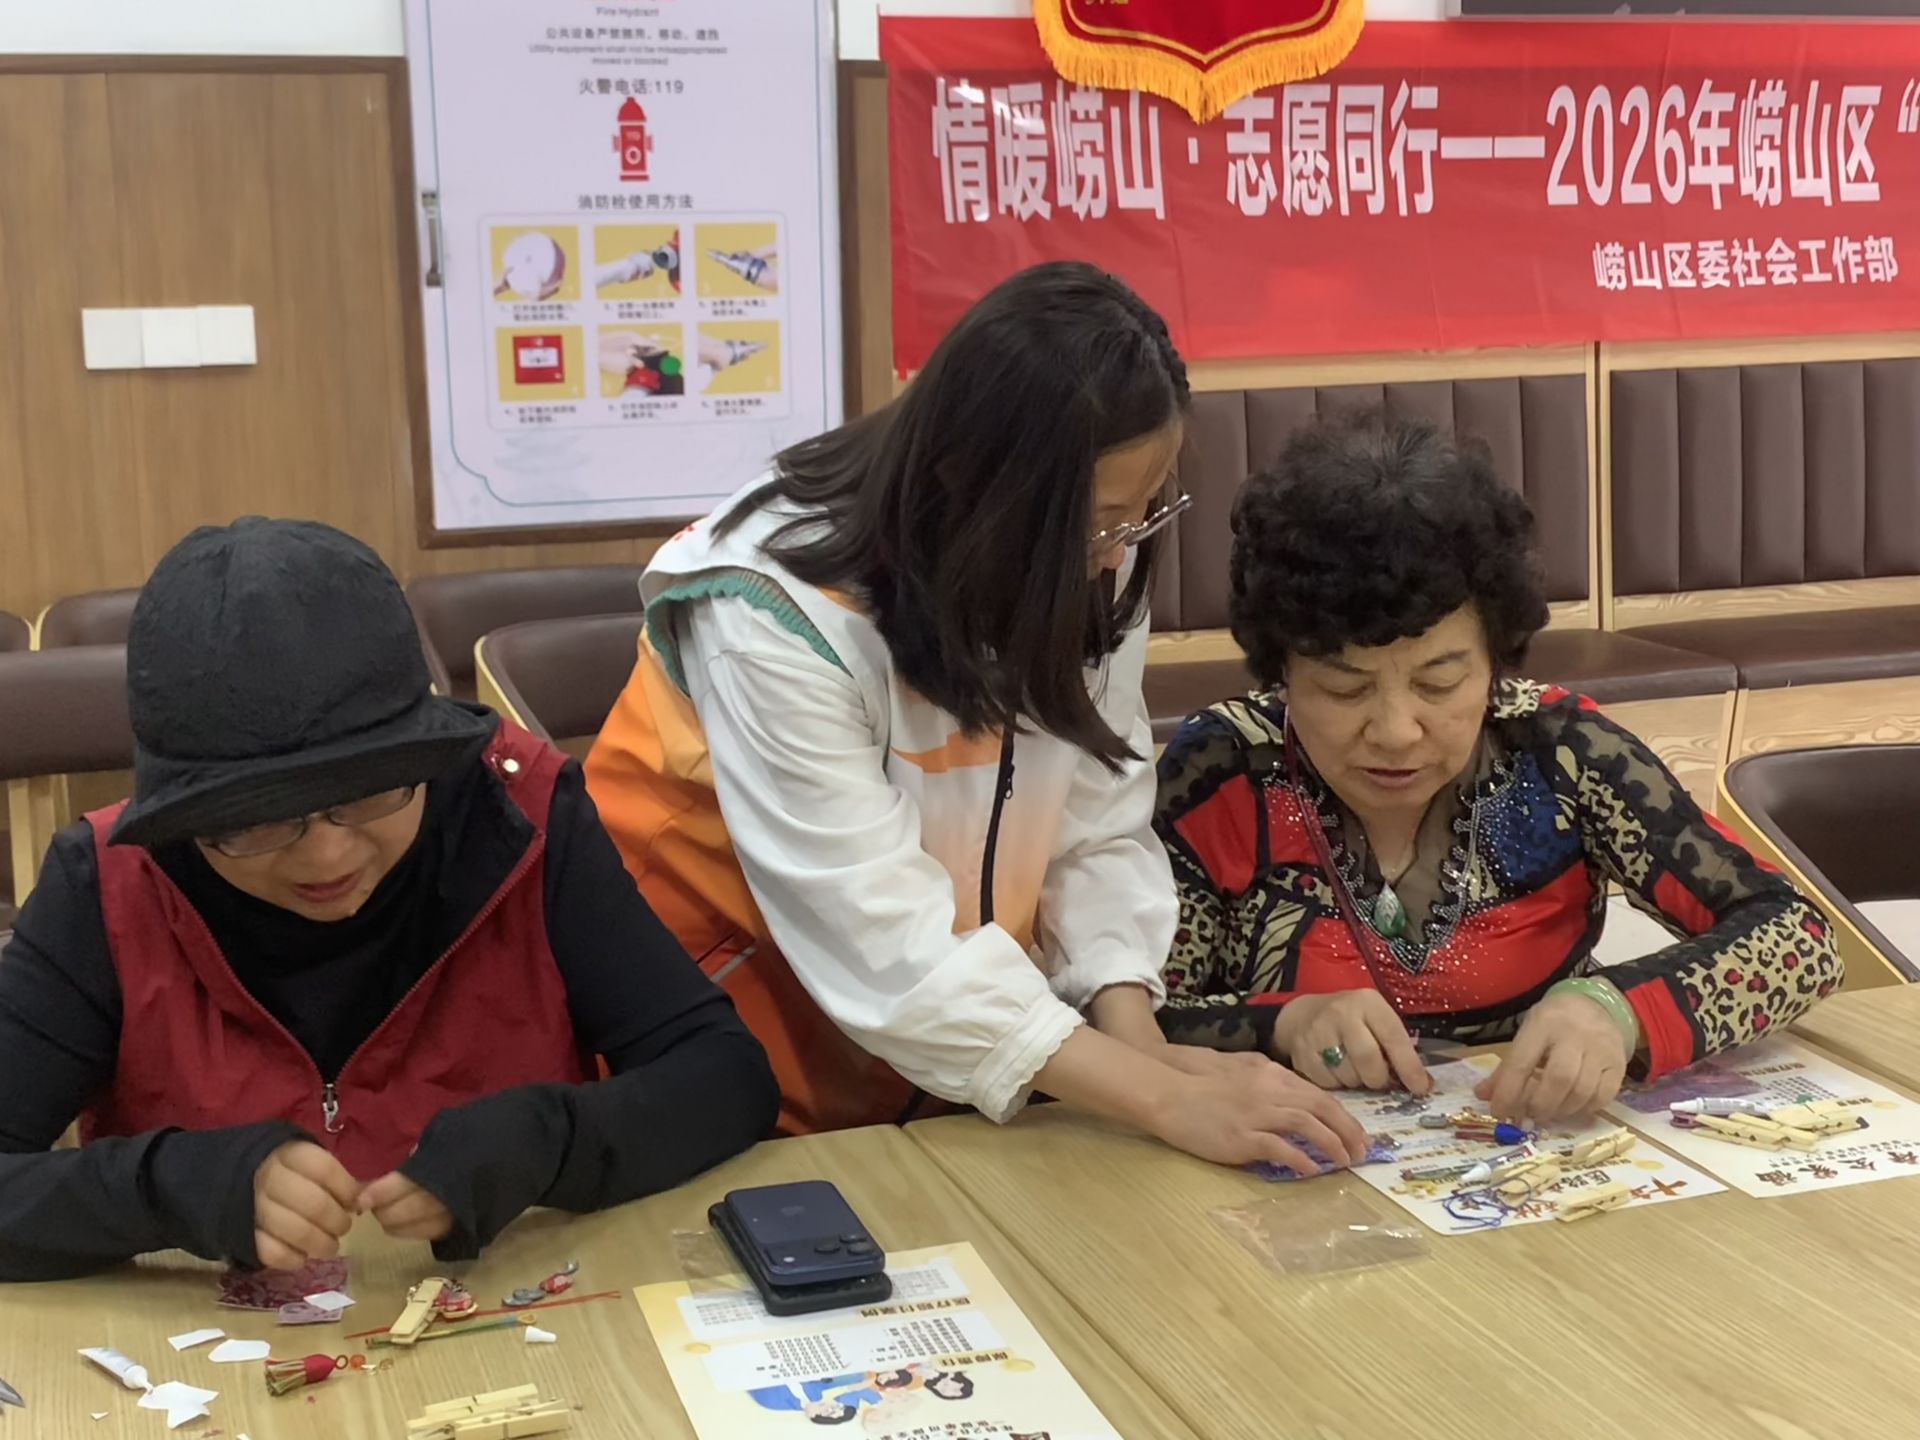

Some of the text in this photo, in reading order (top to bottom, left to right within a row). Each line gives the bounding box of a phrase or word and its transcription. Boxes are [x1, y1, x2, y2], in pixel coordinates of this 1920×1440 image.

[1593, 235, 1898, 290] 崂山区委社会工作部
